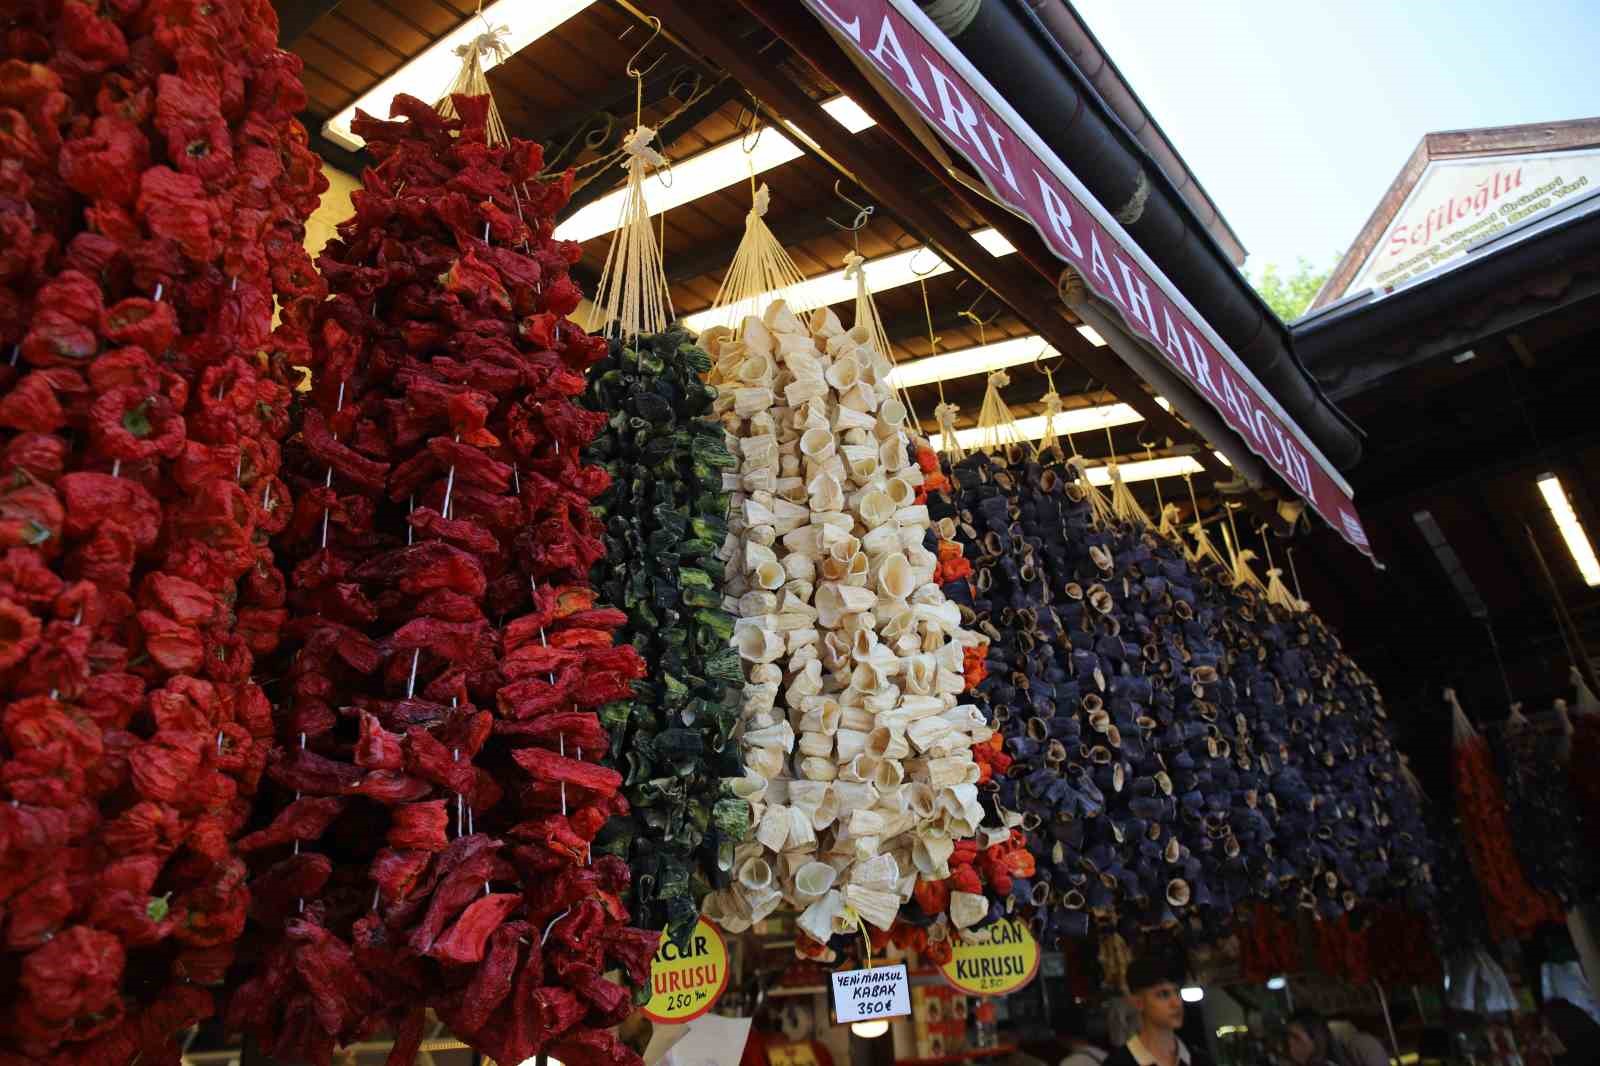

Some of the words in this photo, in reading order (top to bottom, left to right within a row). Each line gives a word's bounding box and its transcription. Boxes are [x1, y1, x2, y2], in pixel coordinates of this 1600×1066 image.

[653, 936, 709, 962] CUR
[653, 963, 718, 994] URUSU
[956, 955, 1024, 980] KURUSU
[666, 993, 692, 1011] 250
[853, 984, 896, 999] KABAK
